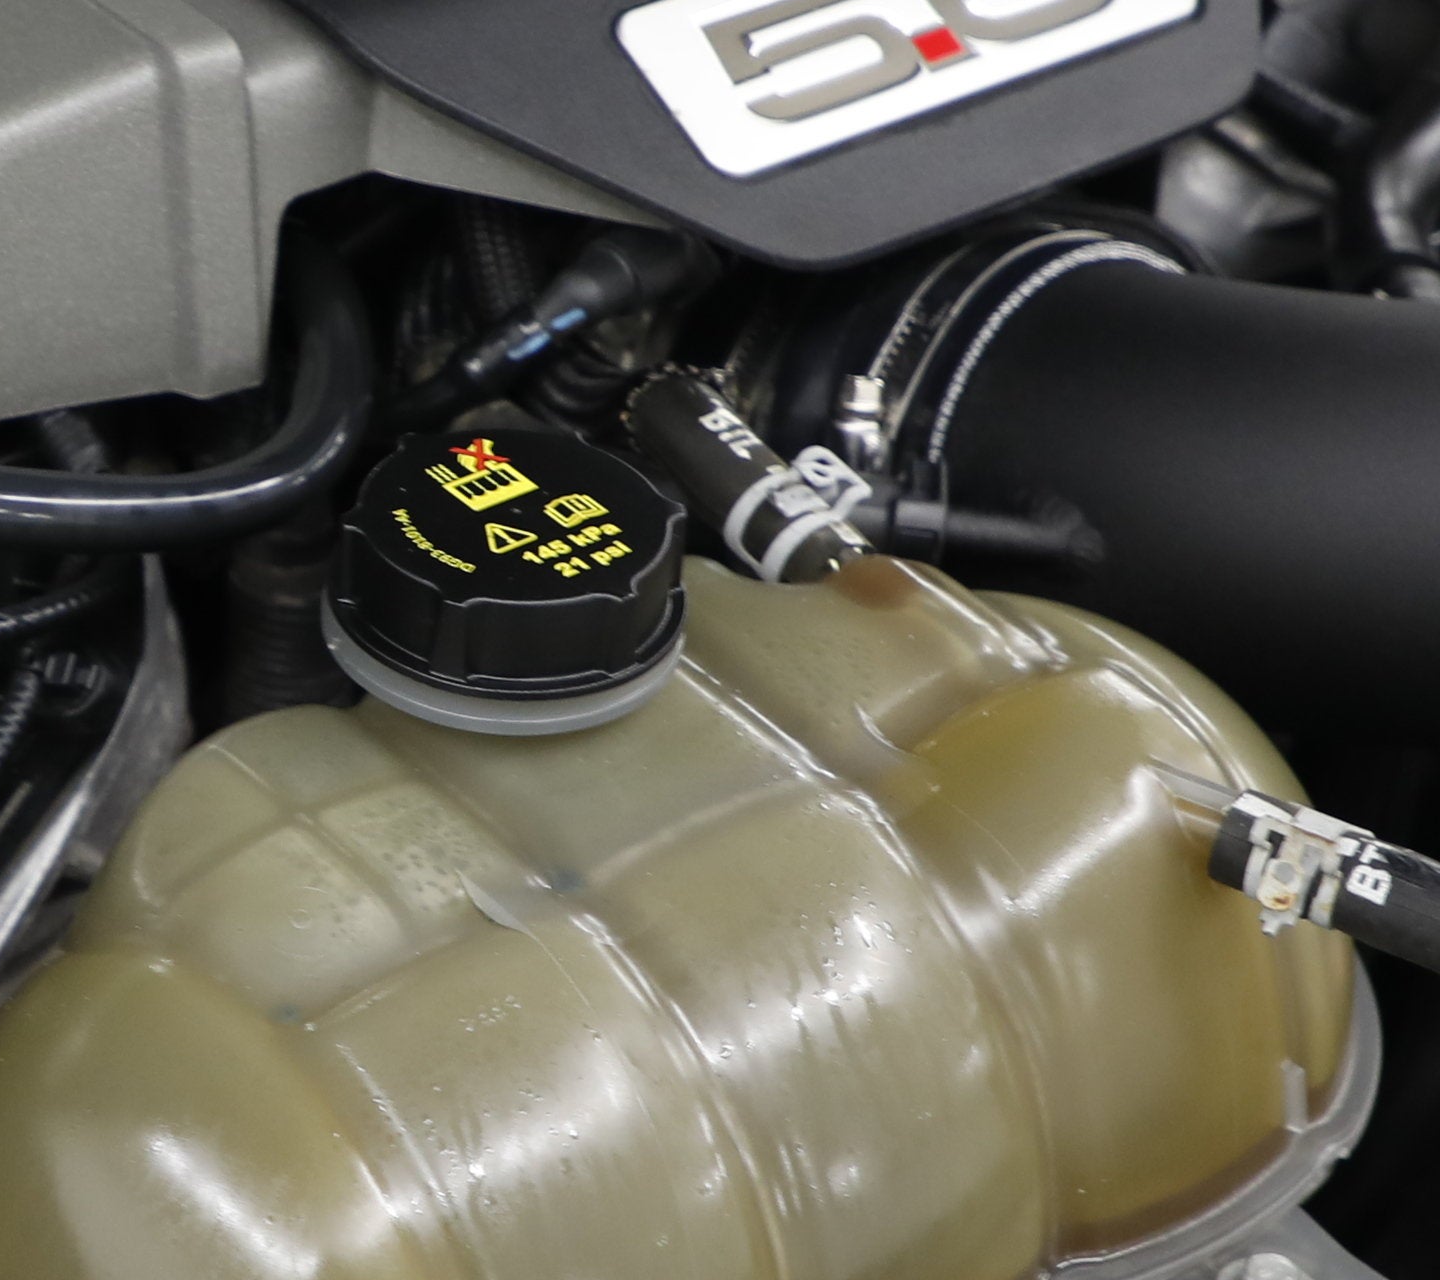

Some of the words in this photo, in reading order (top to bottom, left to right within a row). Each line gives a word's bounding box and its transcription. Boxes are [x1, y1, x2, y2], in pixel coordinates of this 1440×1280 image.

[521, 537, 573, 566] 145
[566, 522, 624, 548] kPa
[552, 556, 592, 579] 21
[588, 538, 634, 567] psi
